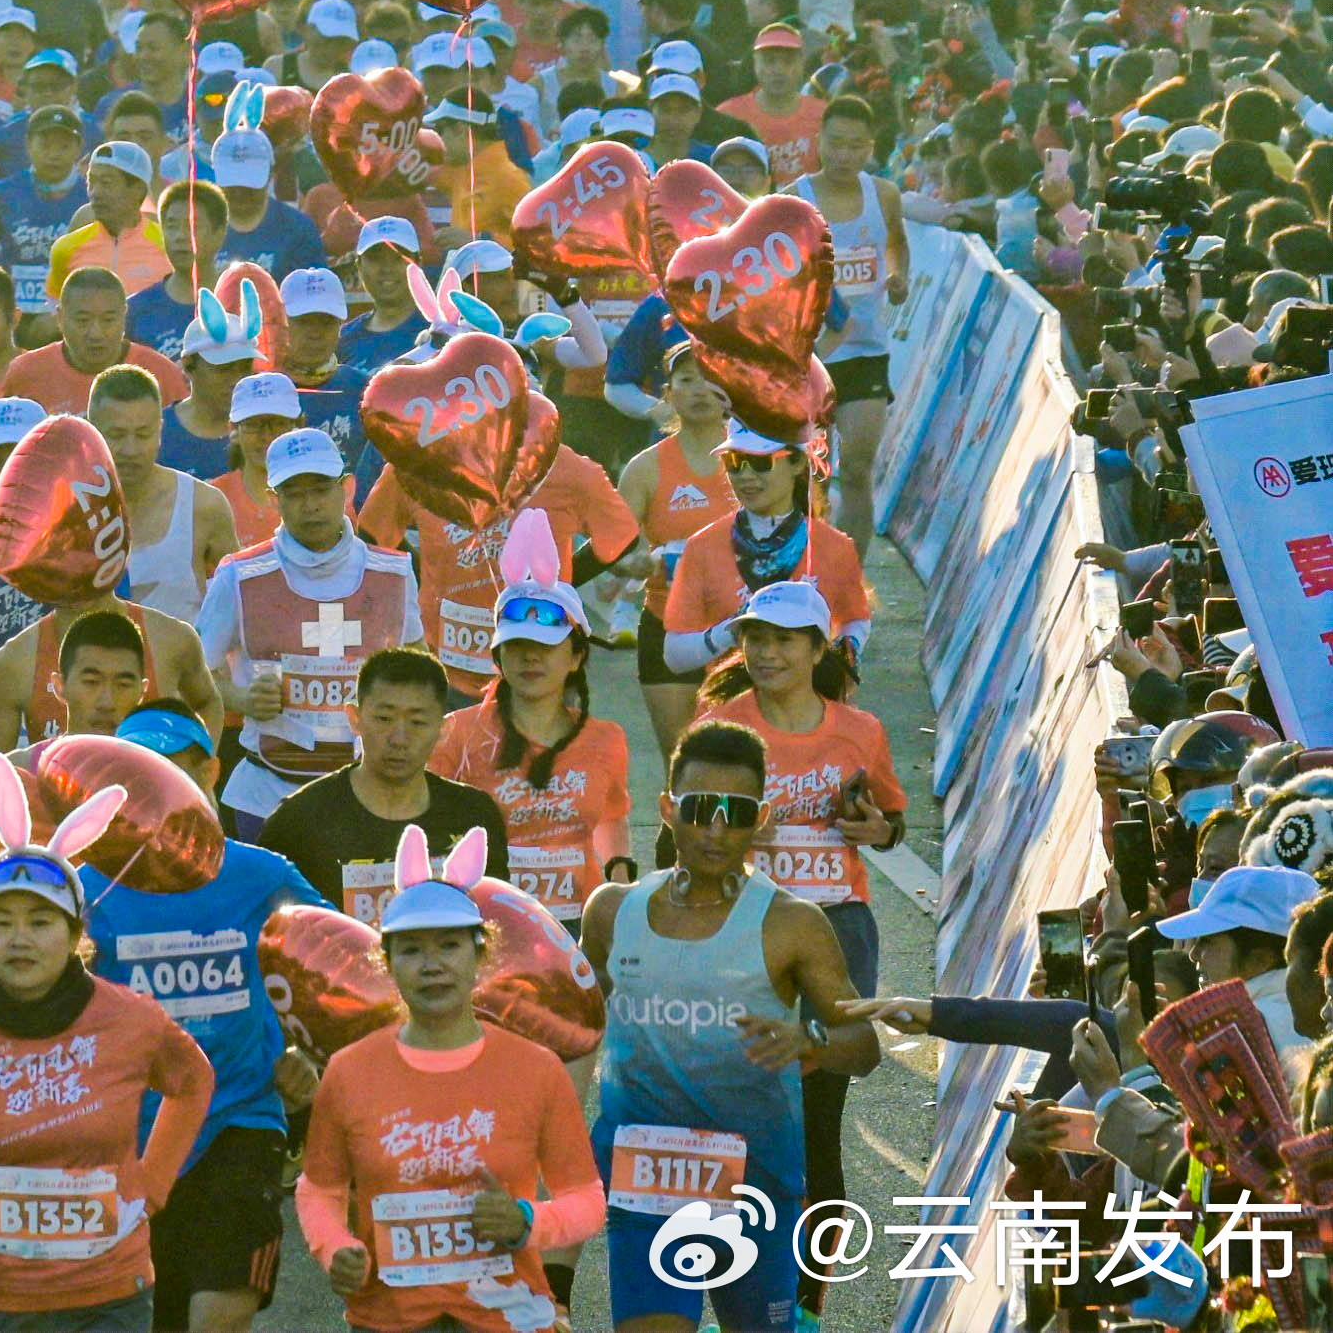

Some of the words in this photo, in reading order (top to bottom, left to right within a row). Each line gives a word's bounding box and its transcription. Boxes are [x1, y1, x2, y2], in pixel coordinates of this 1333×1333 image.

[536, 156, 626, 238] 2:45
[694, 230, 802, 322] 2:30
[404, 363, 511, 447] 2:30
[71, 466, 128, 591] 2:00
[130, 955, 244, 995] A0064
[5, 1072, 90, 1115] 迎新春
[634, 1155, 723, 1192] B1117
[0, 1199, 105, 1235] B1352
